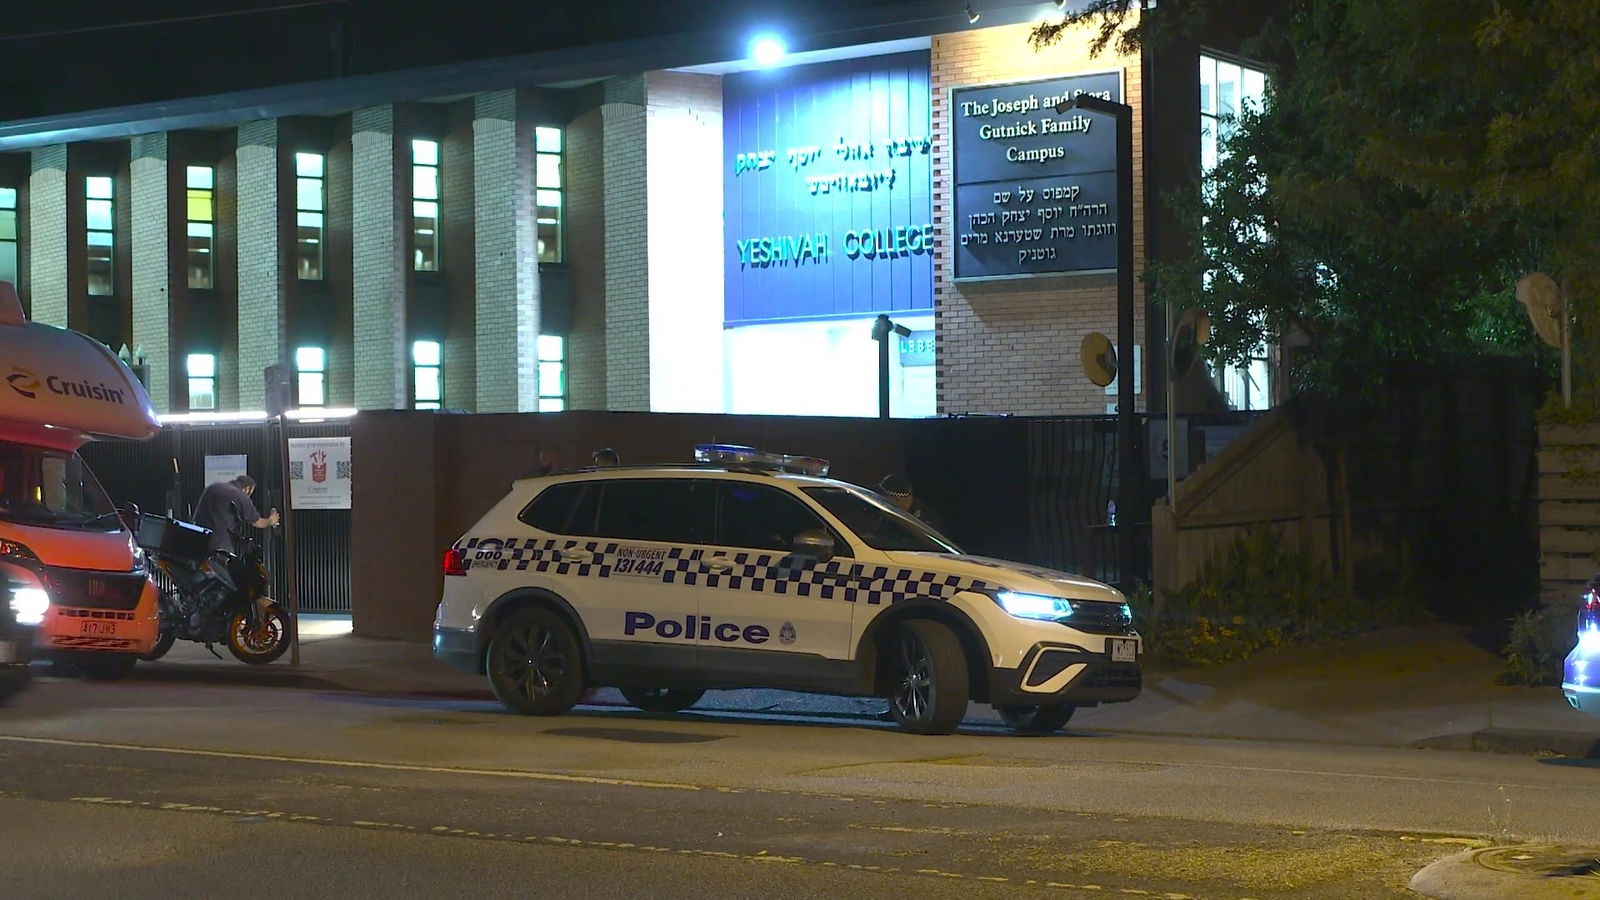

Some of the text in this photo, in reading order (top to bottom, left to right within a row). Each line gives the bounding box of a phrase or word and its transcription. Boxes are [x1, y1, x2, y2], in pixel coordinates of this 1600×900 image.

[961, 101, 990, 117] The
[990, 95, 1039, 117] Joseph
[1043, 90, 1069, 108] and
[979, 115, 1092, 140] Gutnick Family
[1006, 146, 1065, 162] Campus
[993, 185, 1080, 204] קמפוס על שם
[968, 212, 996, 230] הכהן
[1001, 210, 1031, 227] יצחק
[1037, 207, 1063, 224] יוסף
[960, 223, 1117, 246] וזוגתו מרת שטערנא מרים
[737, 224, 934, 265] YESHIVAH COLLEGE
[1018, 247, 1057, 265] גוטניק
[46, 375, 124, 404] Cruisin'
[475, 551, 503, 560] 000
[617, 548, 666, 560] NON-URGENT
[624, 611, 770, 644] Police
